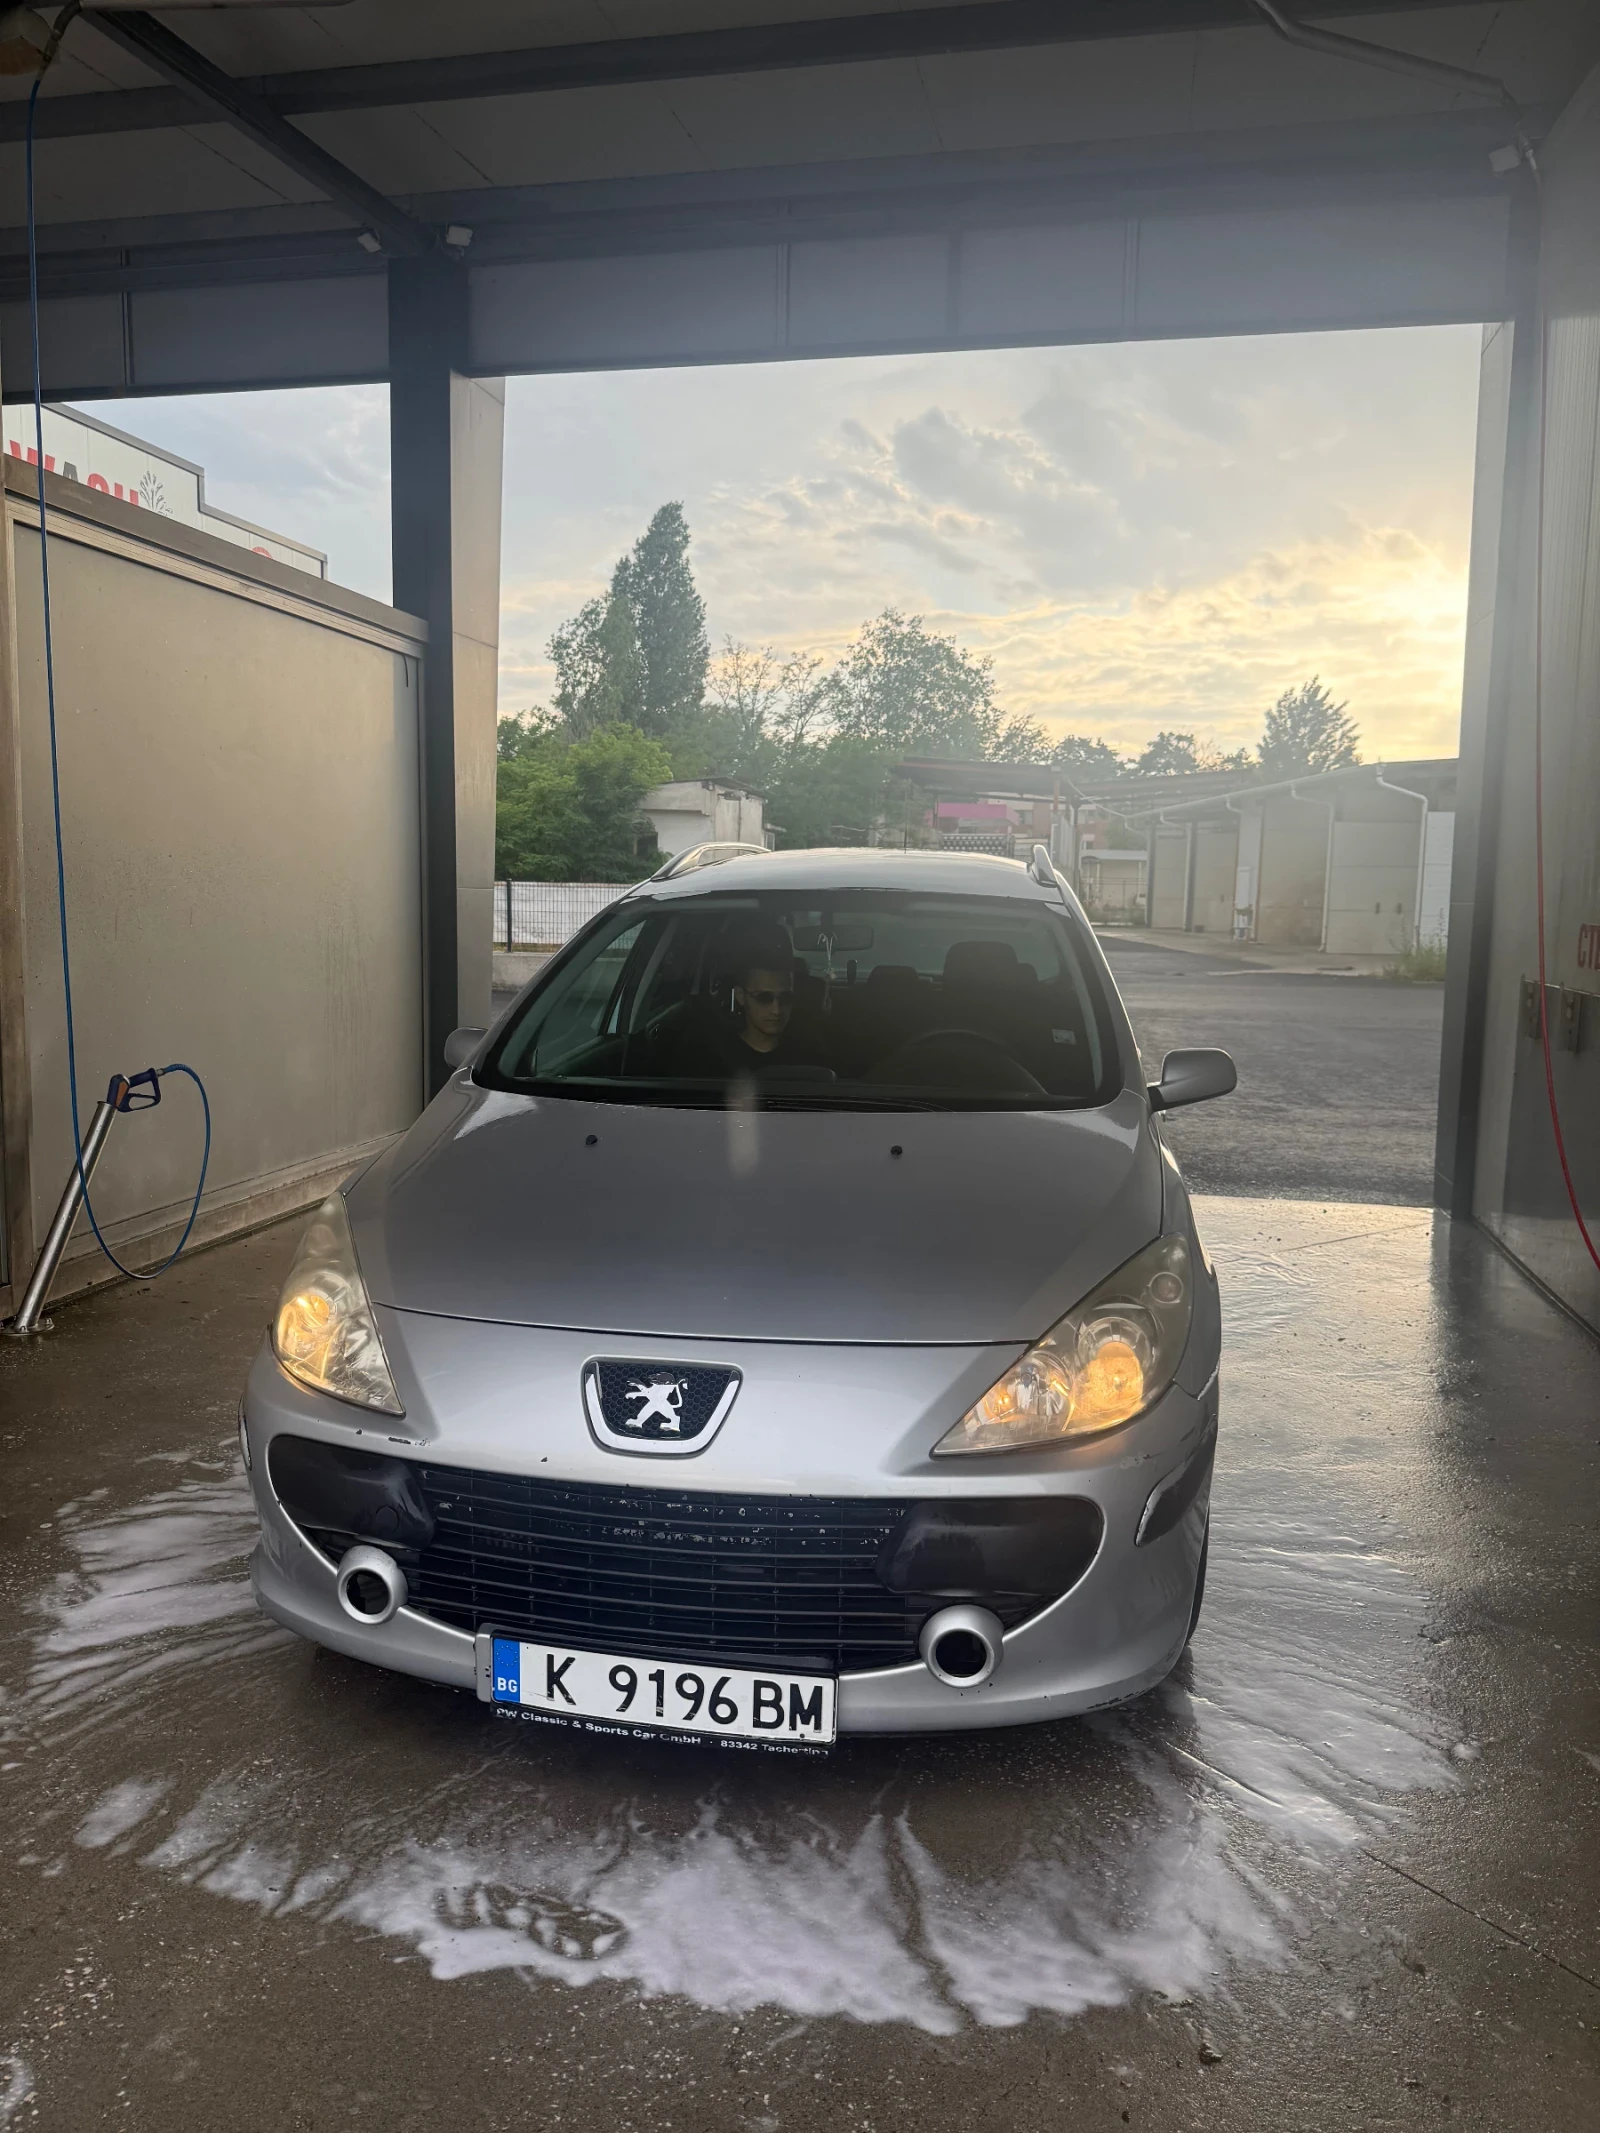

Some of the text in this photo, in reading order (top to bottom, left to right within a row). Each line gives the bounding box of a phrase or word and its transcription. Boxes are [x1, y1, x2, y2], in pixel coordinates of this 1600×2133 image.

[497, 1676, 518, 1693] BG
[546, 1653, 823, 1733] K 9196 BM
[521, 1711, 568, 1726] Classic
[585, 1722, 629, 1737] Sports
[632, 1729, 657, 1740] Car
[720, 1740, 758, 1750] 83342
